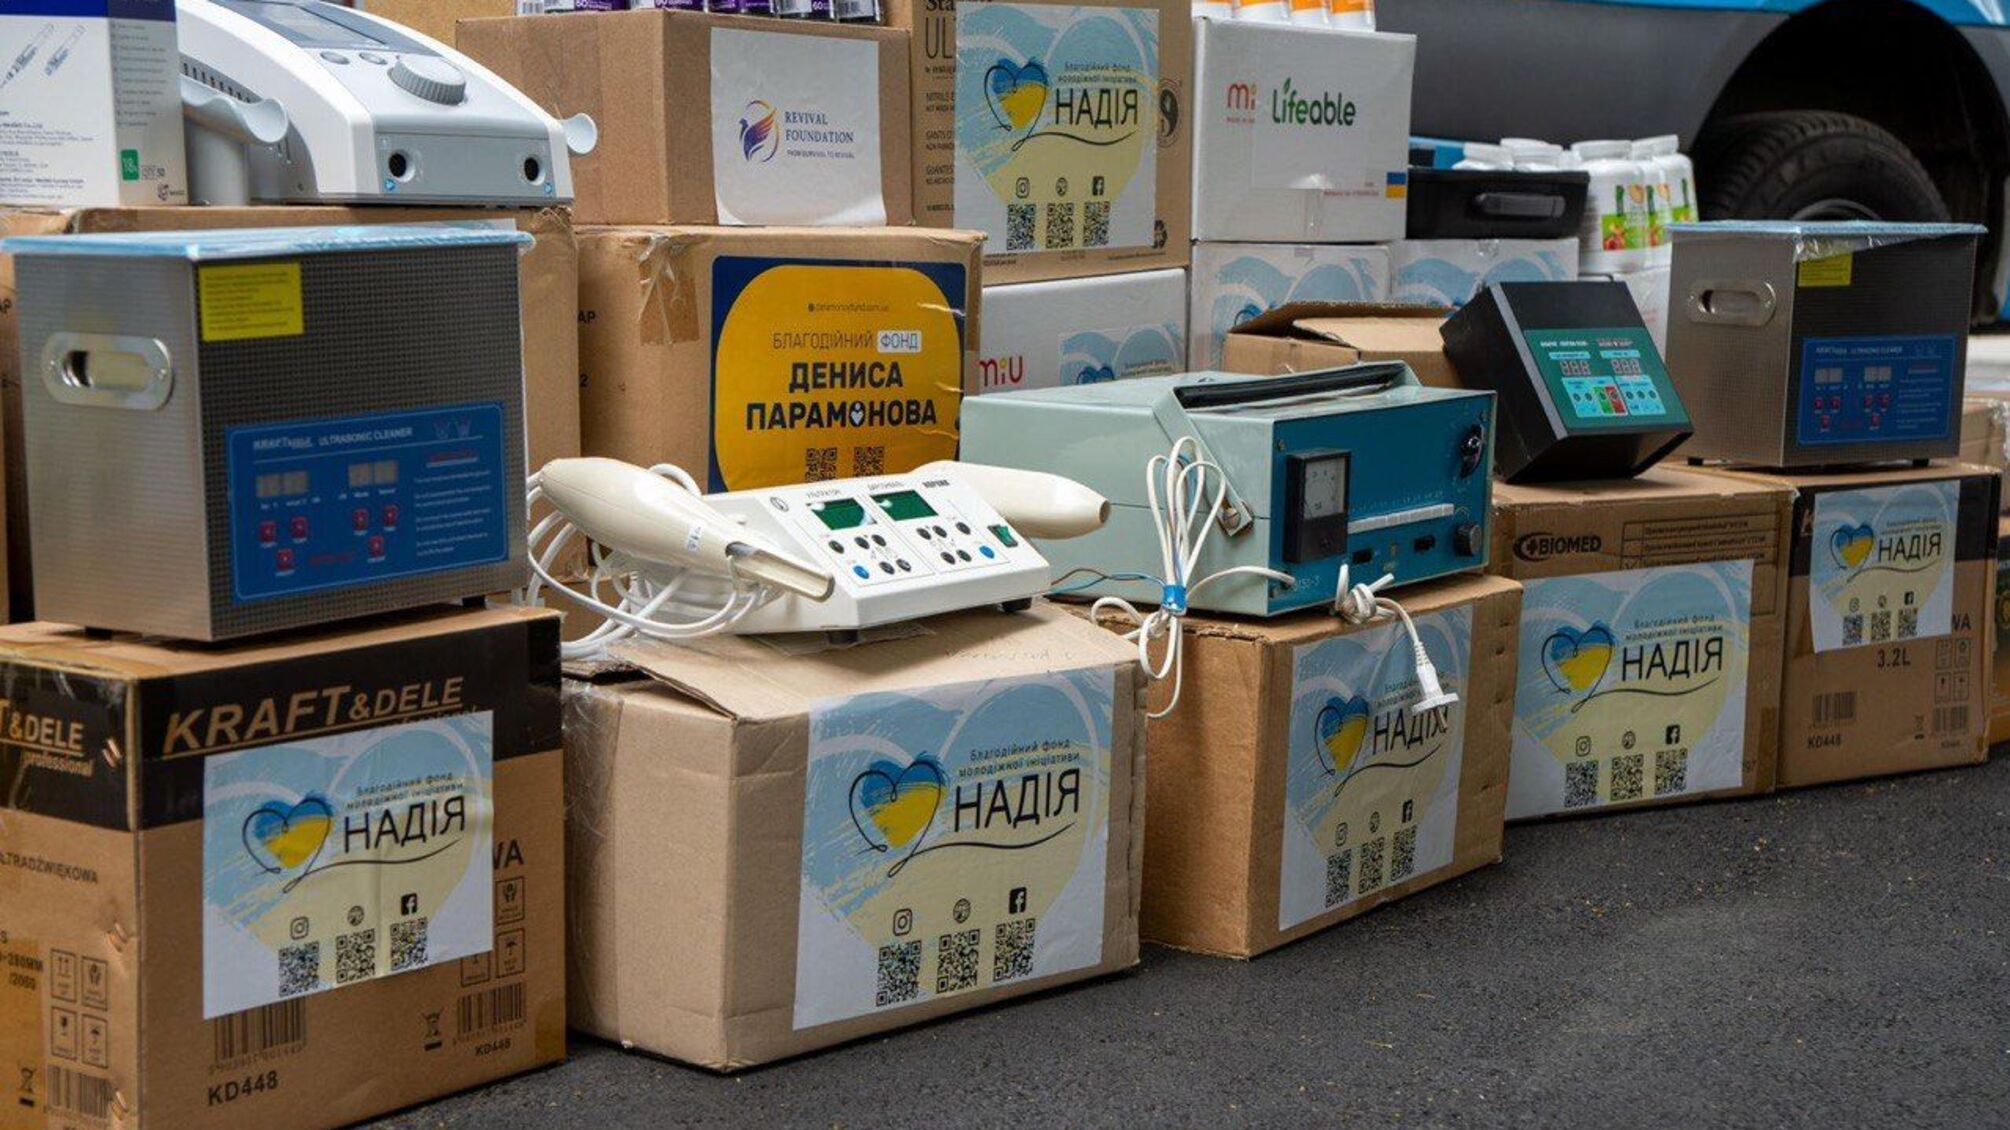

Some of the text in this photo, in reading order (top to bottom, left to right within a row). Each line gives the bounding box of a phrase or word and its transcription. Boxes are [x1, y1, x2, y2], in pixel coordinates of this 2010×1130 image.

[785, 111, 828, 125] REVIVAL
[1055, 88, 1138, 129] НАДІЯ
[1272, 79, 1357, 126] Lifeable
[785, 129, 854, 143] FOUNDATION
[772, 330, 919, 350] БЛАГОДІЙНИЙ ФОНД
[789, 361, 904, 394] ДЕНИСА
[746, 400, 938, 431] ПАРАМОНОВА
[1540, 534, 1602, 555] BIOMED
[1878, 532, 1942, 563] НАДІЯ
[1622, 635, 1723, 682] НАДІЯ
[1877, 648, 1911, 669] 3.2L
[162, 677, 464, 754] KRAFT&DELE
[954, 768, 1080, 832] НАДІЯ
[344, 795, 465, 854] НАДІЯ
[208, 1070, 278, 1107] KD448
